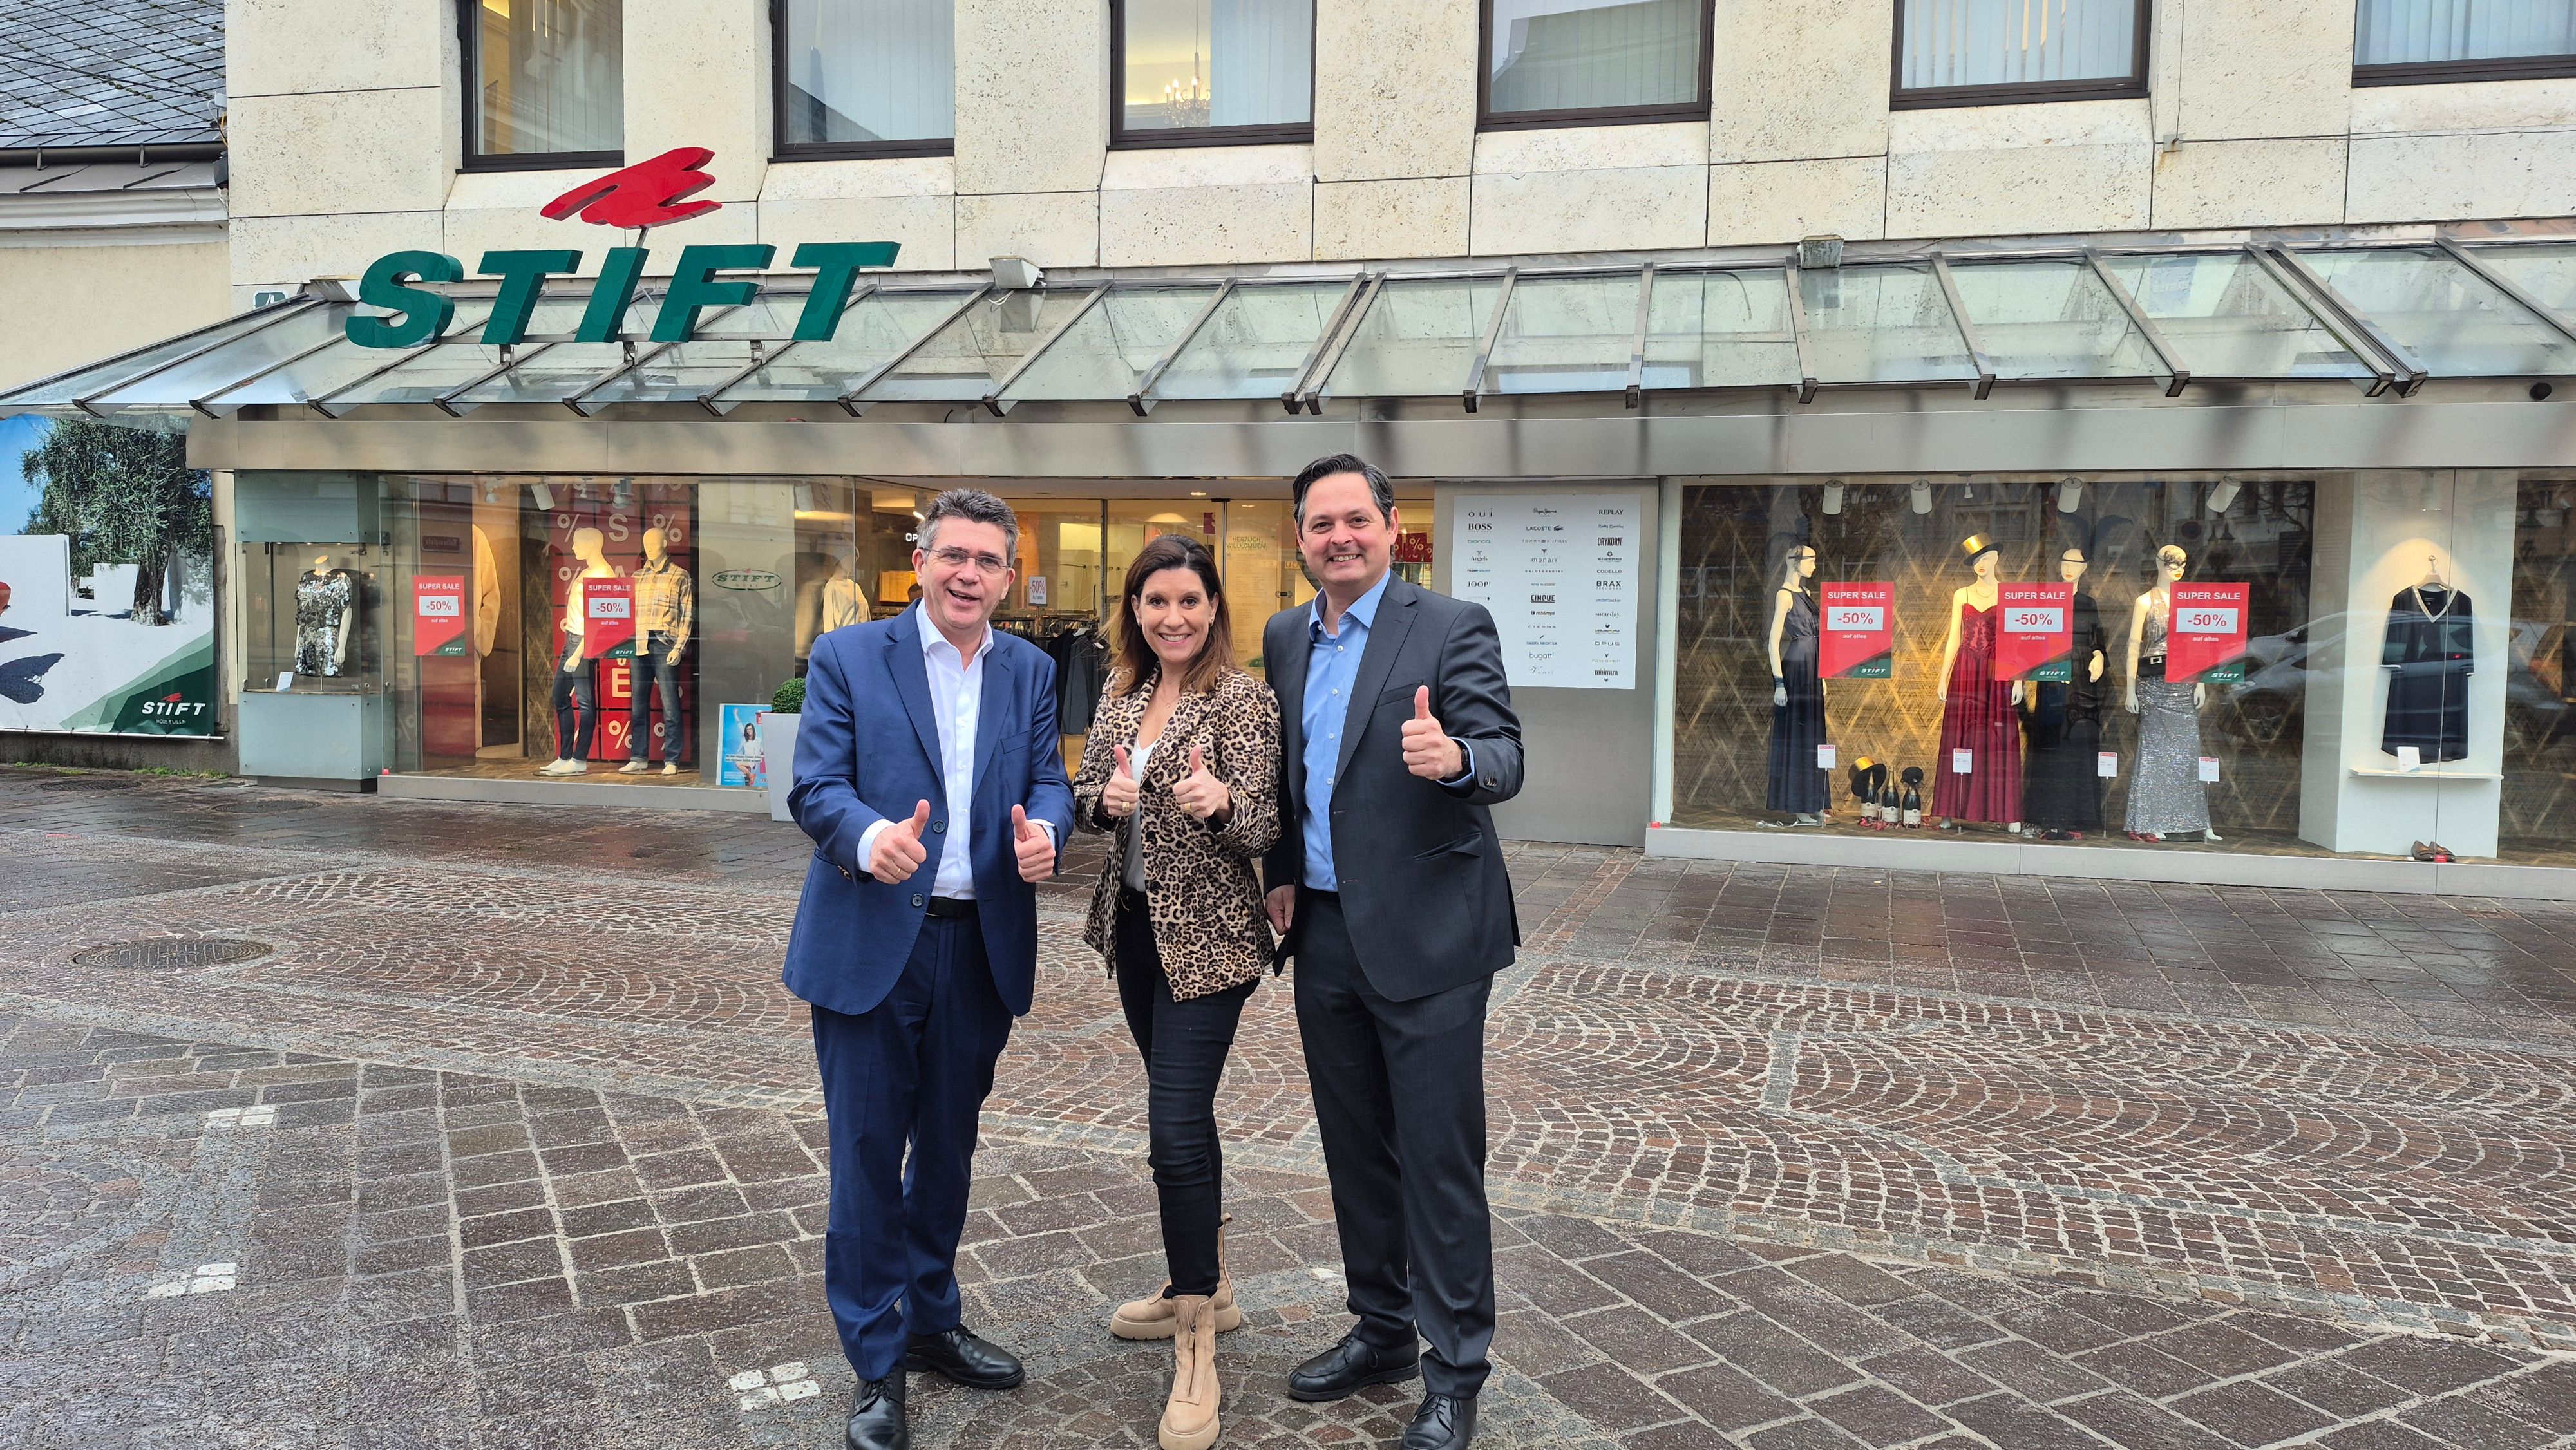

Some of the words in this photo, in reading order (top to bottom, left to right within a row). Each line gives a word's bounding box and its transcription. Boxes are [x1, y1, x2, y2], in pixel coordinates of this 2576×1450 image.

[345, 241, 902, 349] STIFT
[1468, 508, 1492, 517] oui
[608, 513, 629, 542] S
[1030, 579, 1046, 594] -50%
[2177, 592, 2211, 600] SUPER
[2213, 592, 2240, 600] SALE
[426, 600, 452, 610] -50%
[596, 602, 623, 613] -50%
[1837, 612, 1873, 625] -50%
[2014, 613, 2053, 626] -50%
[2187, 614, 2227, 626] -50%
[1529, 652, 1553, 661] bugatti
[612, 668, 632, 697] E
[141, 701, 207, 715] STIFT
